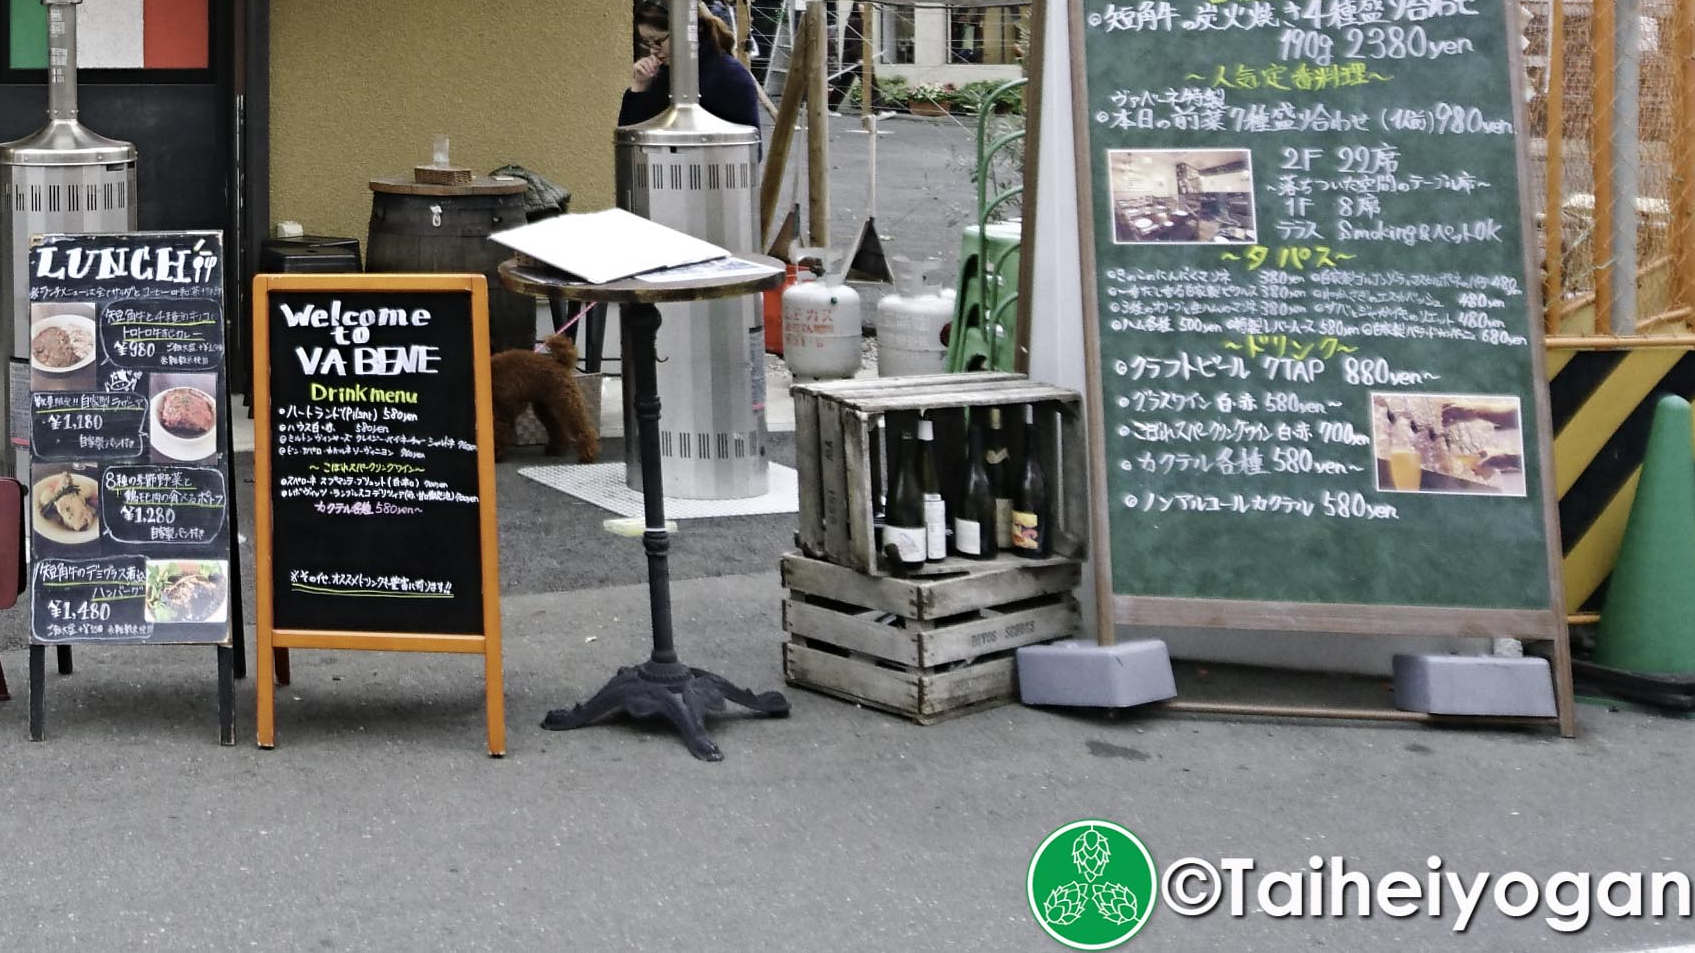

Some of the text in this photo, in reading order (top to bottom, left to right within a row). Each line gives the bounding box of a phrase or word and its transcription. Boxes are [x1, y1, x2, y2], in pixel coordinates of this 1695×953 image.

[1282, 148, 1322, 171] 2F
[1286, 195, 1382, 218] 1F 8席
[1276, 220, 1325, 241] テラス
[36, 245, 192, 283] LUNCH
[280, 300, 431, 328] Welcome
[330, 326, 370, 345] to
[113, 341, 156, 358] ¥980
[295, 345, 442, 376] VA BENE
[1129, 352, 1251, 381] クラフトビール
[311, 382, 418, 404] Drink menu
[48, 413, 104, 430] ¥1,180
[1322, 492, 1399, 521] 580yen
[48, 601, 111, 621] ¥1,480
